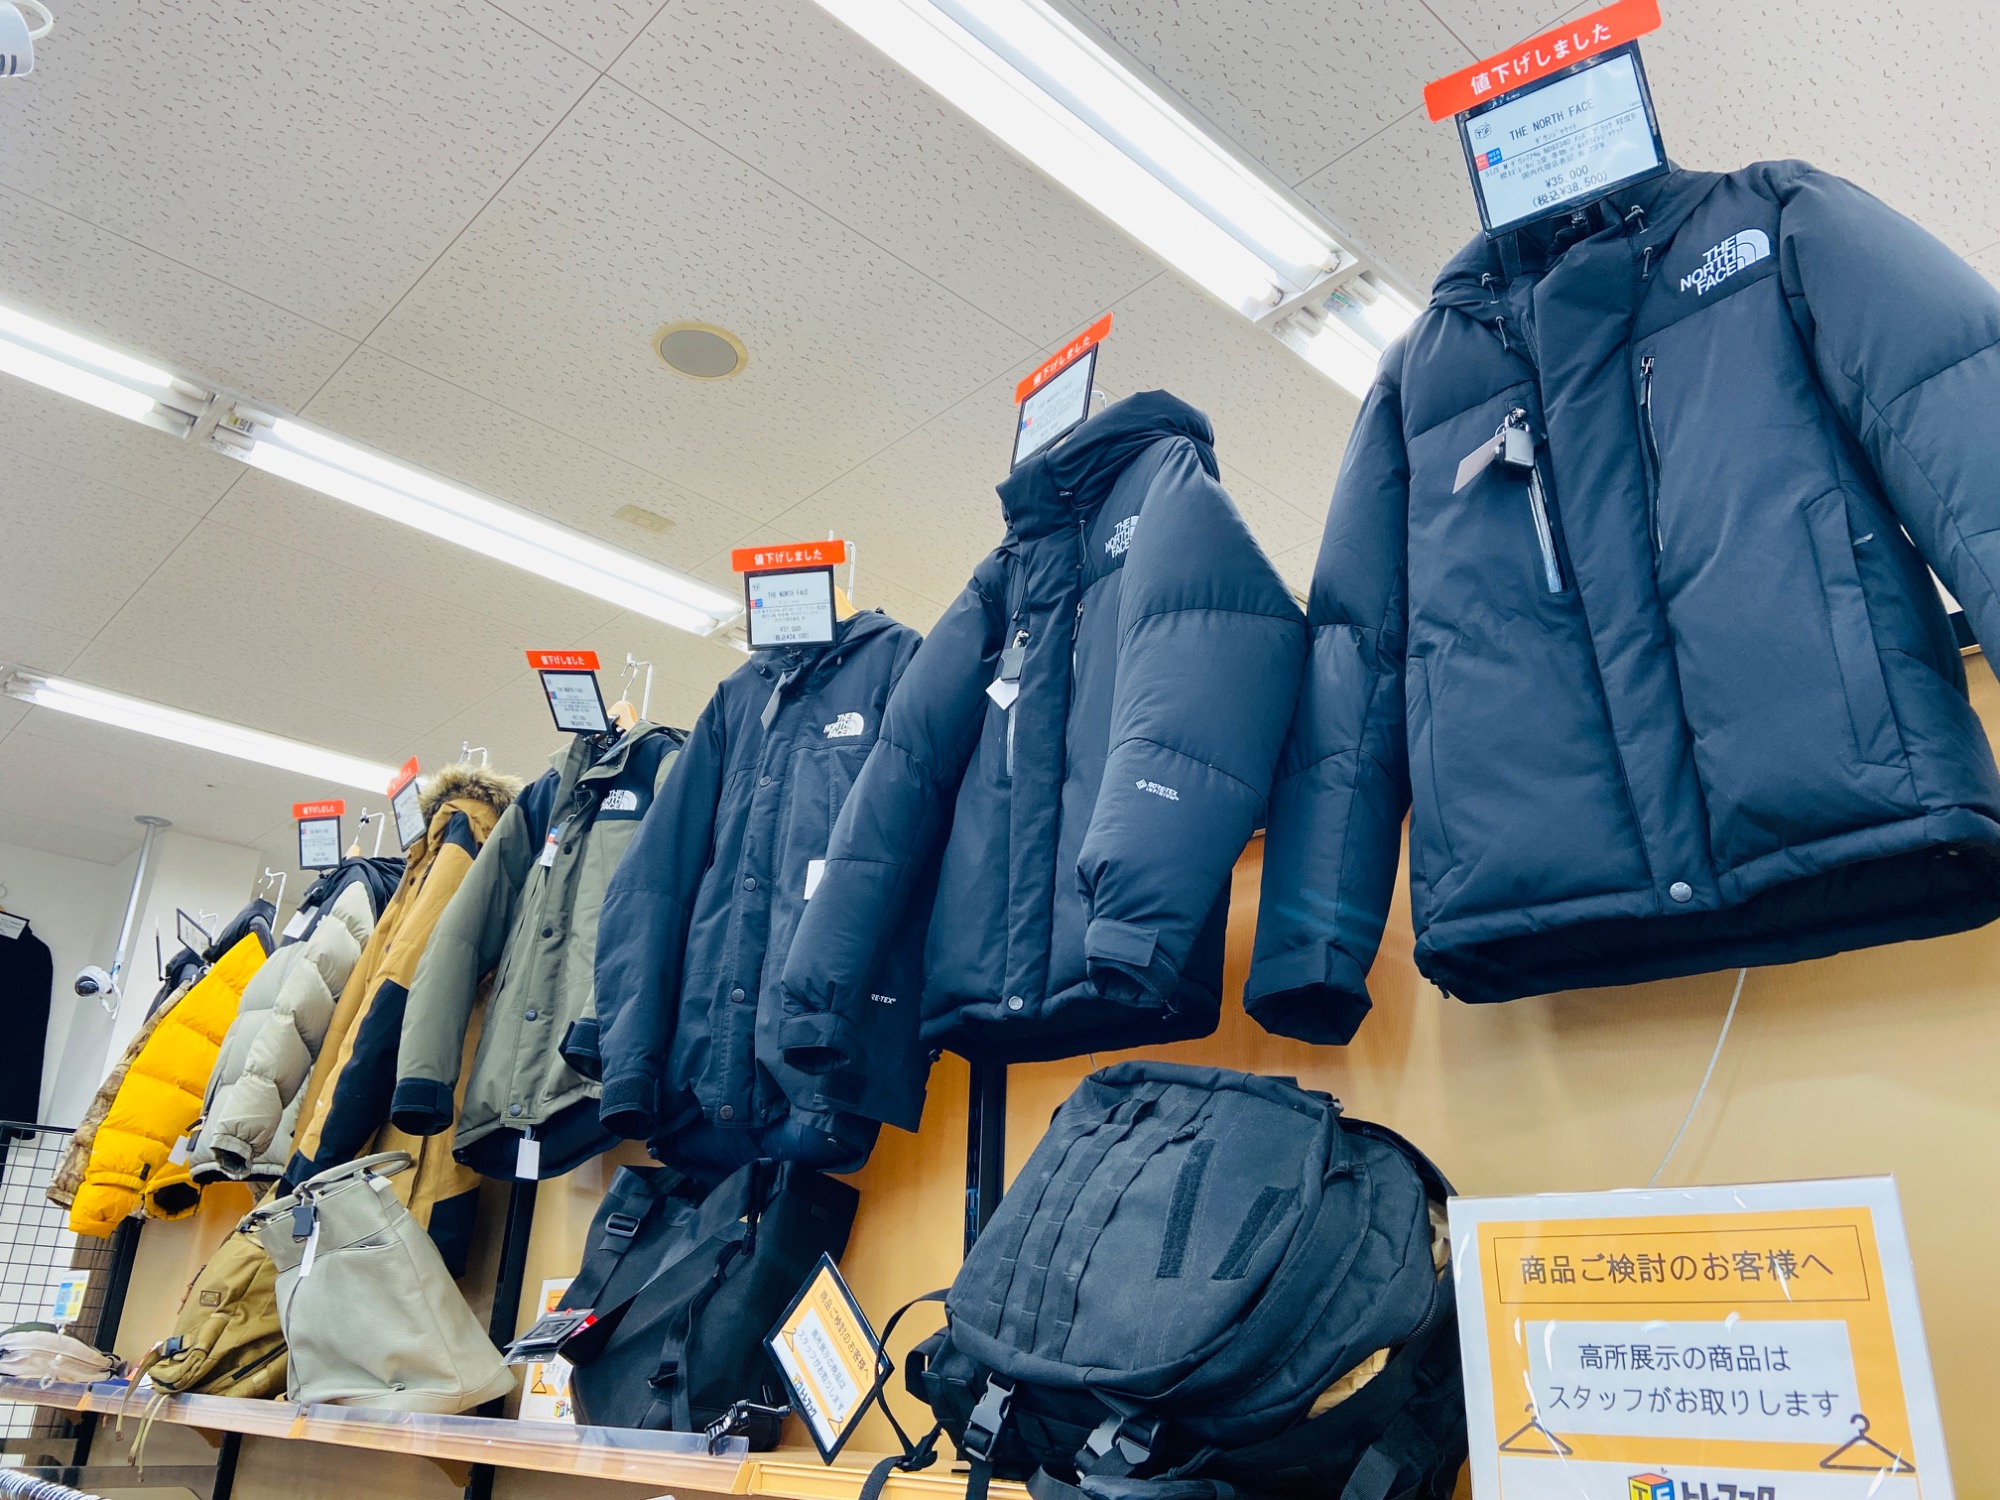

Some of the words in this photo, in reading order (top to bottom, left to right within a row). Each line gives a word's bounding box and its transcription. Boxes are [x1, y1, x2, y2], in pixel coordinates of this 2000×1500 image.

[1469, 23, 1612, 96] 値下げしました
[1509, 125, 1528, 141] THE
[1532, 110, 1564, 131] NORTH
[1567, 98, 1594, 117] FACE
[1702, 234, 1736, 262] THE
[1680, 247, 1736, 292] NORTH
[1697, 260, 1737, 296] FACE
[1033, 335, 1091, 387] 値下げしました
[1105, 527, 1130, 553] NORTH
[1114, 517, 1131, 534] THE
[754, 549, 823, 566] 値下げしました
[1112, 540, 1130, 558] FACE
[837, 712, 852, 722] THE
[1520, 1248, 1833, 1287] 商品ご検討のお客様へ
[820, 1290, 870, 1380] 商品ご検討のお客様へ
[1579, 1343, 1792, 1373] 高所展示の商品は
[1549, 1385, 1840, 1418] スタッフがお取りします
